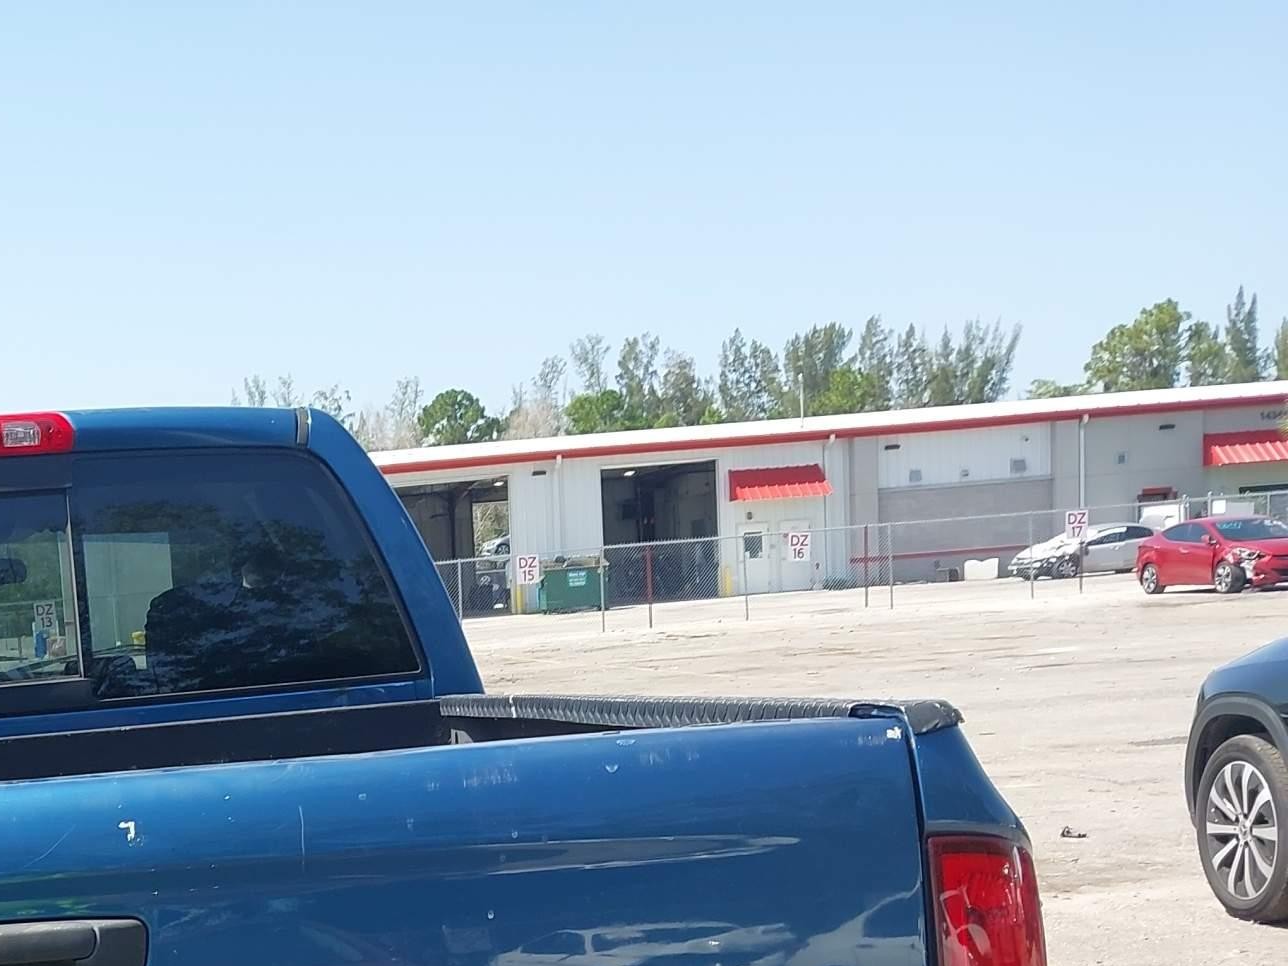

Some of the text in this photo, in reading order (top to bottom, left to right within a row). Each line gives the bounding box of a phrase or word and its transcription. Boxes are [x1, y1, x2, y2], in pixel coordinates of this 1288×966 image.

[1067, 512, 1086, 525] DZ
[1071, 525, 1083, 537] 17
[790, 534, 809, 547] DZ
[792, 547, 805, 559] 16
[518, 556, 537, 569] DZ
[522, 569, 535, 582] 15
[35, 603, 54, 616] DZ
[40, 616, 53, 629] 13
